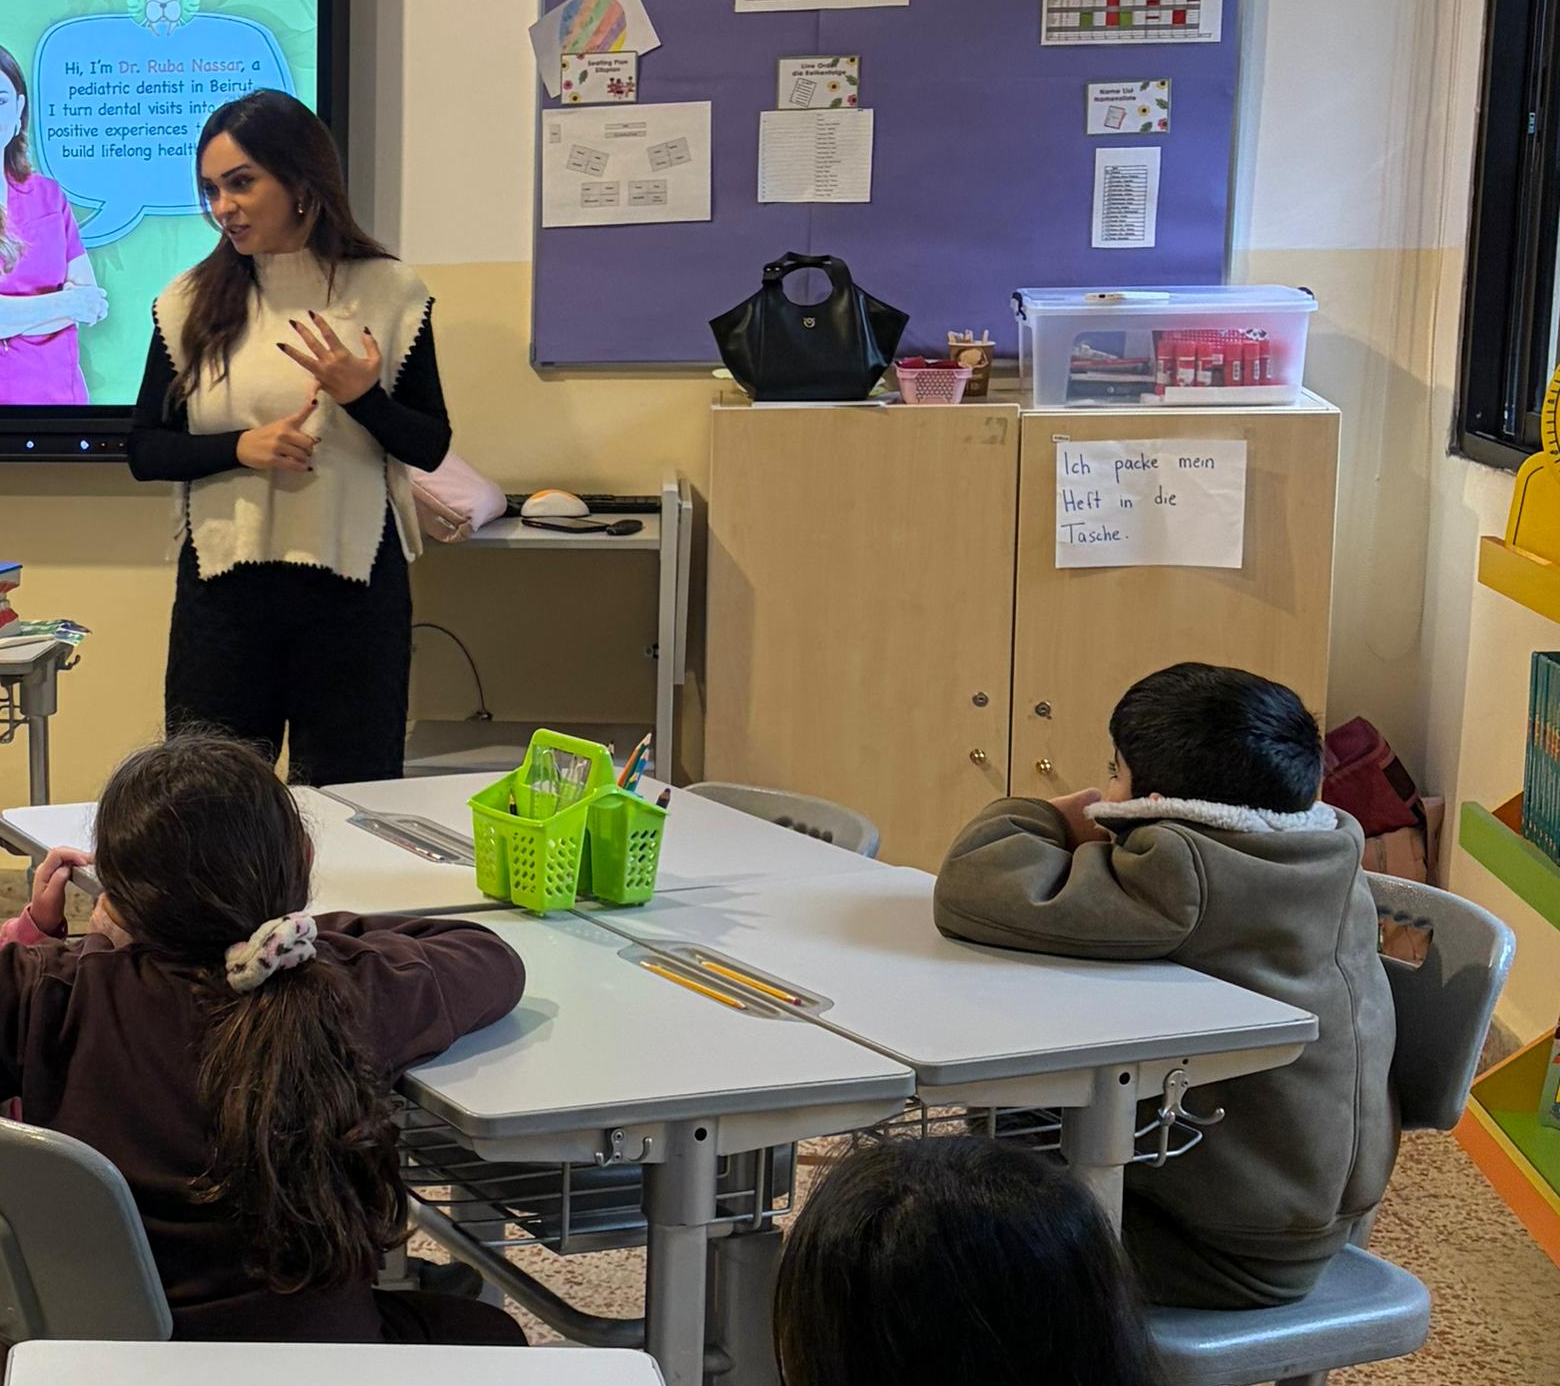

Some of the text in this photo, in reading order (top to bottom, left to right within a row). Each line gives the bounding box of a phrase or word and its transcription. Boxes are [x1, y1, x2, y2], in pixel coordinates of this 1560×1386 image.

[65, 62, 84, 76] Hi,
[119, 60, 140, 74] Dr.
[147, 59, 185, 74] Ruba
[191, 59, 246, 74] Nassar,
[251, 61, 261, 71] a
[69, 82, 130, 100] pediatric
[136, 80, 185, 95] dentist
[191, 79, 204, 93] in
[48, 100, 215, 117] I turn dental visits into
[47, 124, 99, 141] positive
[105, 121, 188, 141] experiences
[62, 145, 95, 158] build
[101, 144, 152, 161] lifelong
[1064, 452, 1215, 484] Ich packe mein
[1062, 485, 1177, 512] Heft in die
[1061, 522, 1129, 544] Tasche.
